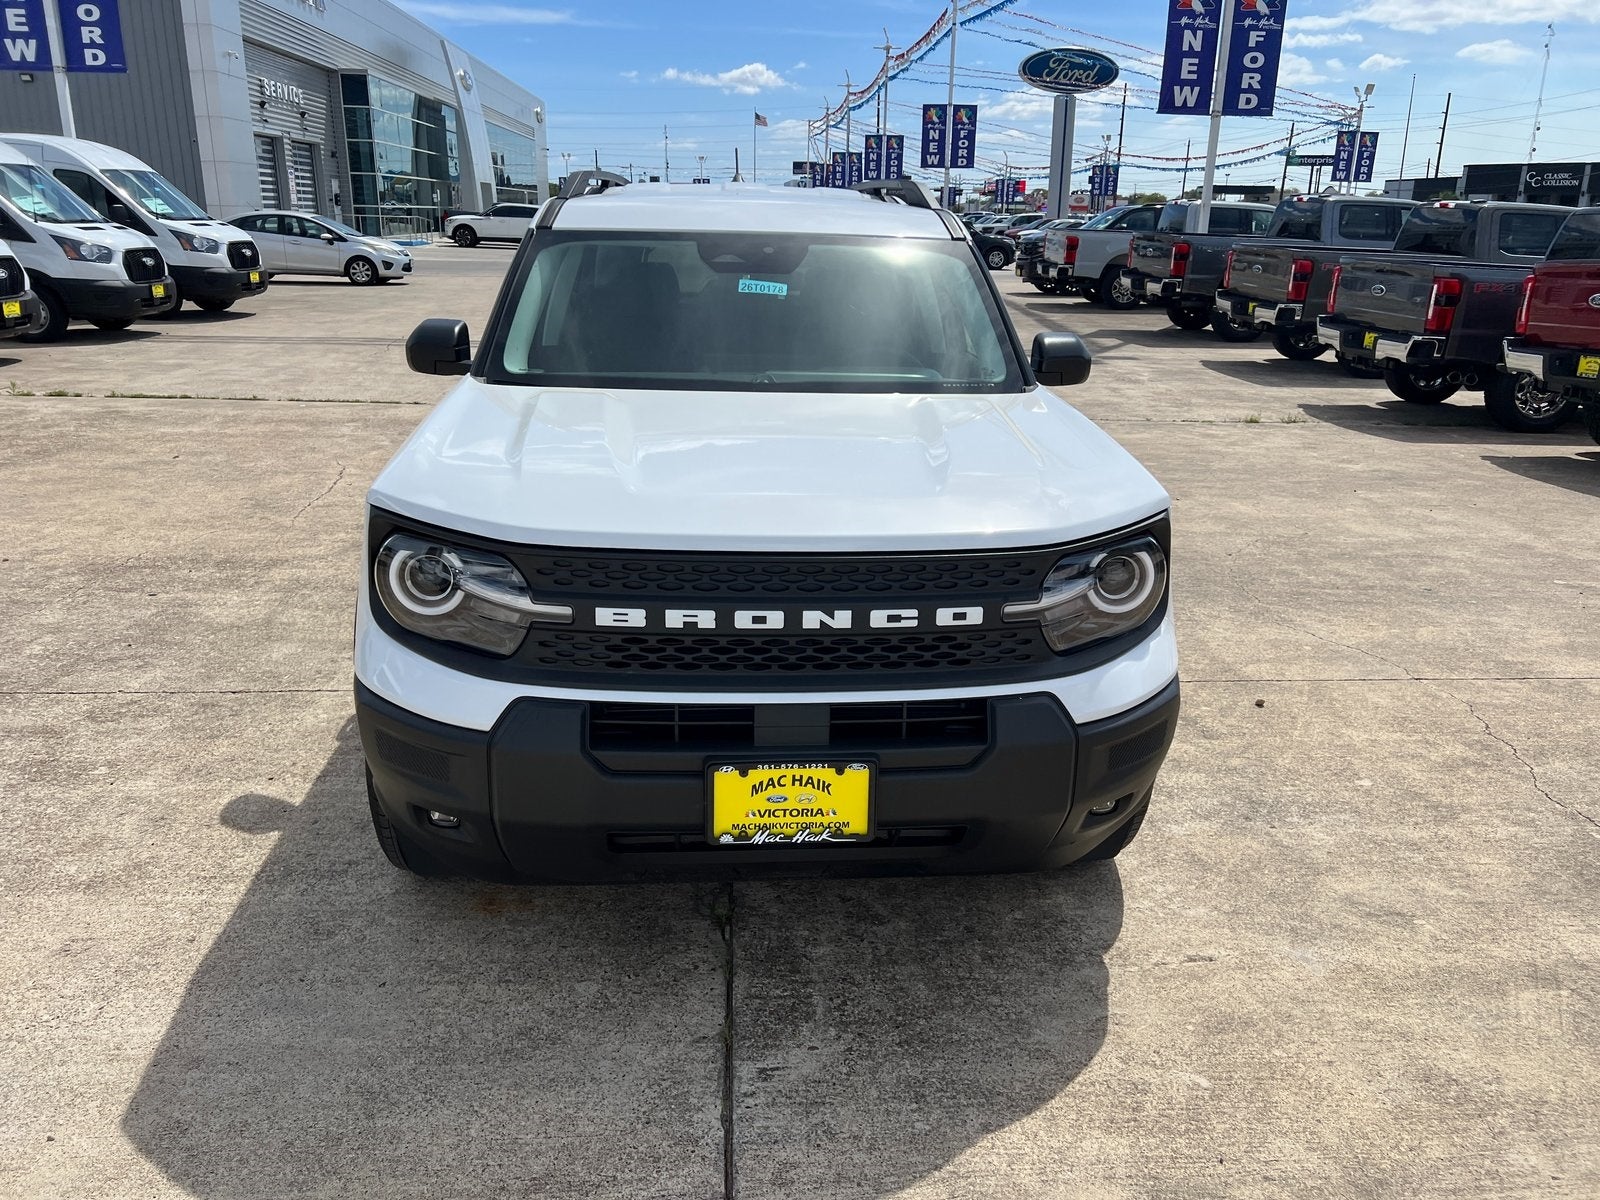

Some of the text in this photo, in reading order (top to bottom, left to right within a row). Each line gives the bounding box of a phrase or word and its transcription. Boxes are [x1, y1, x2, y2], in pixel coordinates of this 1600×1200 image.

[3, 0, 37, 62] EW
[1042, 56, 1101, 83] Ford
[1173, 29, 1203, 108] NEW
[1237, 30, 1267, 110] FORD
[264, 79, 304, 104] SERVICE
[926, 129, 940, 165] NEW
[957, 130, 969, 166] FORD
[1293, 155, 1335, 165] enterpris
[867, 152, 878, 179] NEW
[890, 152, 898, 179] FORD
[1336, 151, 1348, 180] NEW
[1359, 151, 1371, 181] FORD
[1543, 172, 1573, 180] CLASSIC
[741, 282, 785, 294] 26T0178
[594, 605, 984, 630] BRONCO
[751, 774, 833, 798] MAC HAIK
[731, 821, 850, 832] MACHAIKVICTORIA.COM
[756, 808, 826, 819] VICTORIA
[748, 828, 836, 845] Mac Haik
